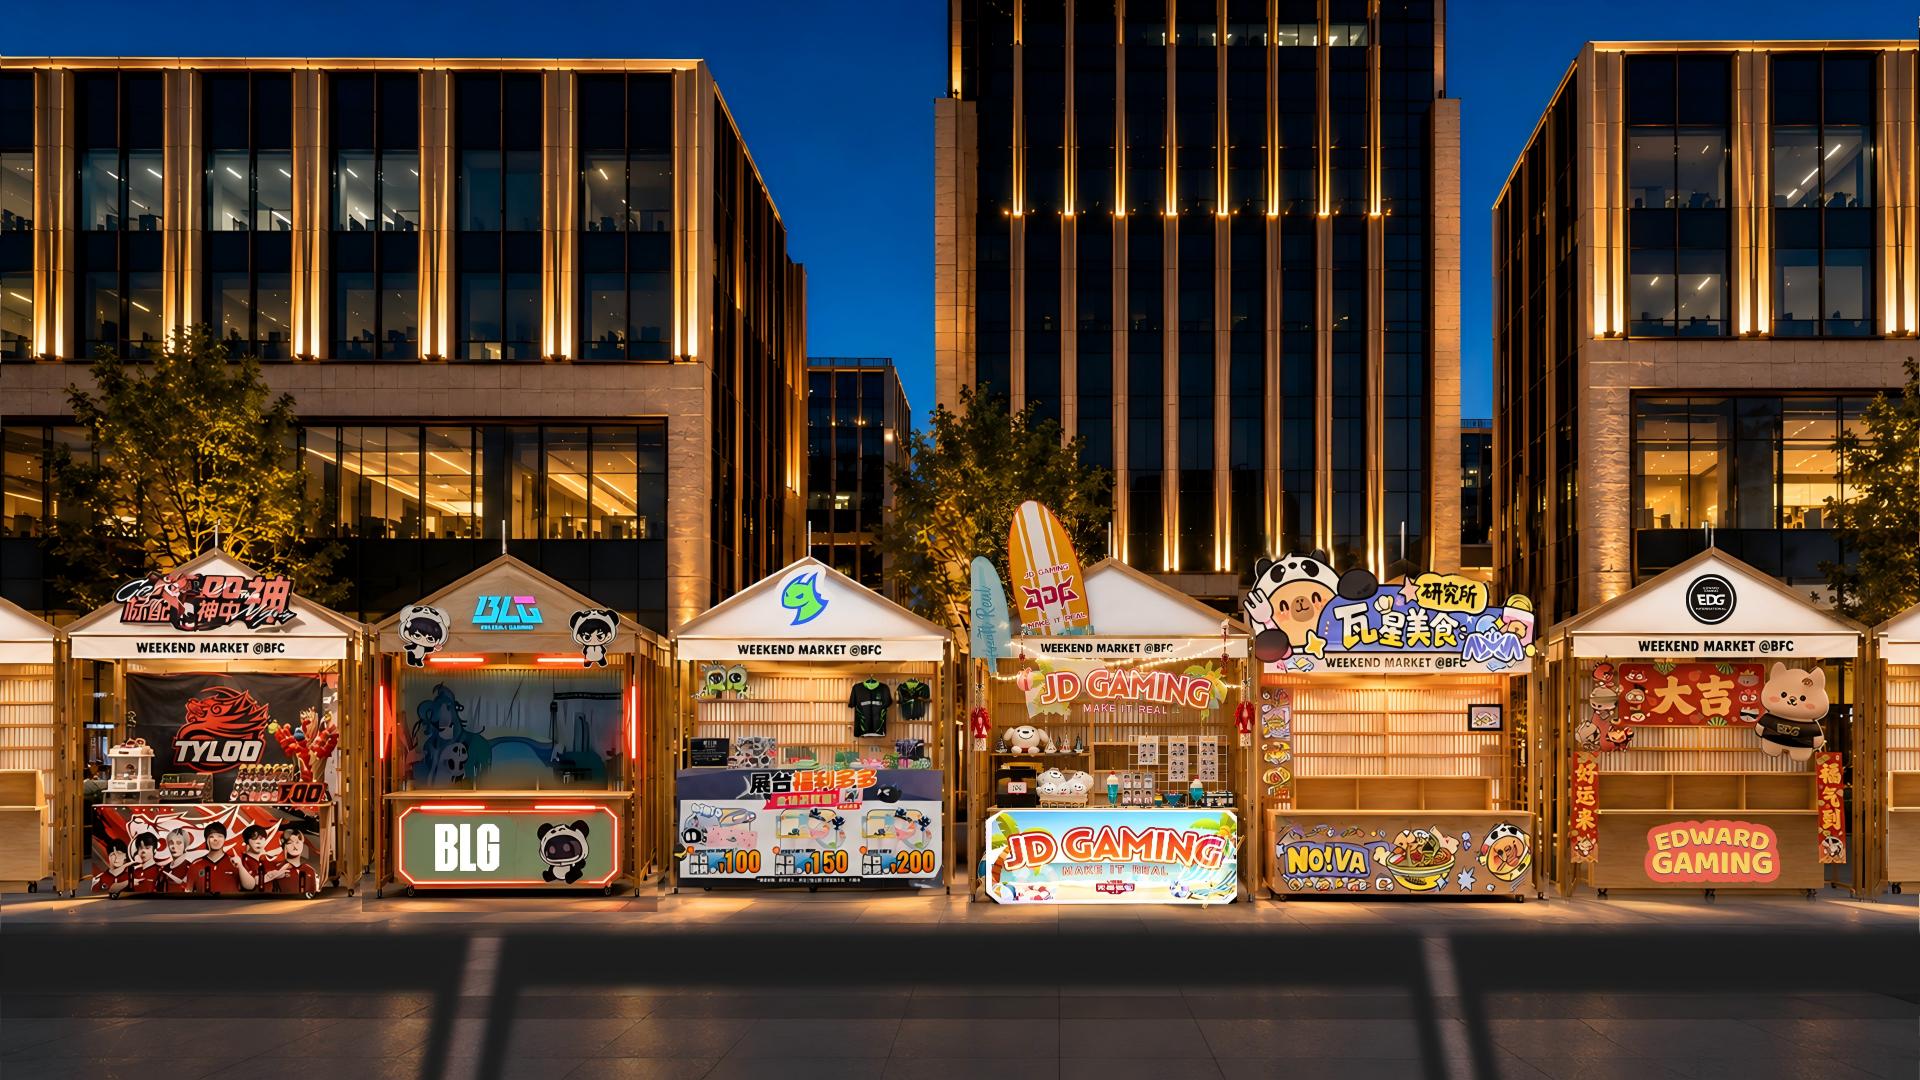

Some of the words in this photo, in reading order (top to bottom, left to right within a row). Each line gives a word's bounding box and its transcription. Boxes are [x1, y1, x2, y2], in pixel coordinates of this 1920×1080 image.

[1038, 564, 1069, 576] GAMING
[1421, 582, 1477, 609] 研究所
[1696, 593, 1726, 606] EDG
[1334, 601, 1459, 650] 瓦星美食
[136, 642, 195, 655] WEEKEND
[200, 642, 249, 655] MARKET
[253, 642, 285, 655] @BFC
[738, 644, 795, 656] WEEKEND
[799, 644, 847, 656] MARKET
[850, 644, 882, 656] @BFC
[1040, 643, 1093, 654] WEEKEND
[1096, 643, 1141, 654] MARKET
[1144, 643, 1174, 654] @BFC
[1638, 640, 1699, 653] WEEKEND
[1703, 640, 1756, 653] MARKET
[1759, 640, 1794, 653] @BFC
[1325, 657, 1381, 669] WEEKEND
[1385, 657, 1432, 669] MARKET
[1041, 671, 1082, 705] JD
[1085, 668, 1212, 709] GAMING
[1651, 676, 1736, 718] 大吉
[1083, 703, 1116, 713] MAKE
[1121, 704, 1132, 713] IT
[1138, 705, 1167, 714] REAL
[174, 740, 262, 762] TYLOO
[749, 769, 877, 794] 展台福利多多
[1575, 762, 1598, 831] 好运来
[1820, 762, 1842, 830] 福气到
[434, 823, 500, 872] BLG
[1003, 830, 1058, 871] JD
[1062, 825, 1226, 870] GAMING
[1653, 827, 1769, 851] EDWARD
[725, 850, 761, 873] 100
[811, 850, 848, 874] 150
[896, 850, 935, 874] 200
[1062, 864, 1103, 876] MAKE
[1110, 864, 1124, 875] IT
[1131, 865, 1169, 876] REAL
[1287, 845, 1366, 874] NO!VA
[1652, 852, 1773, 875] GAMING
